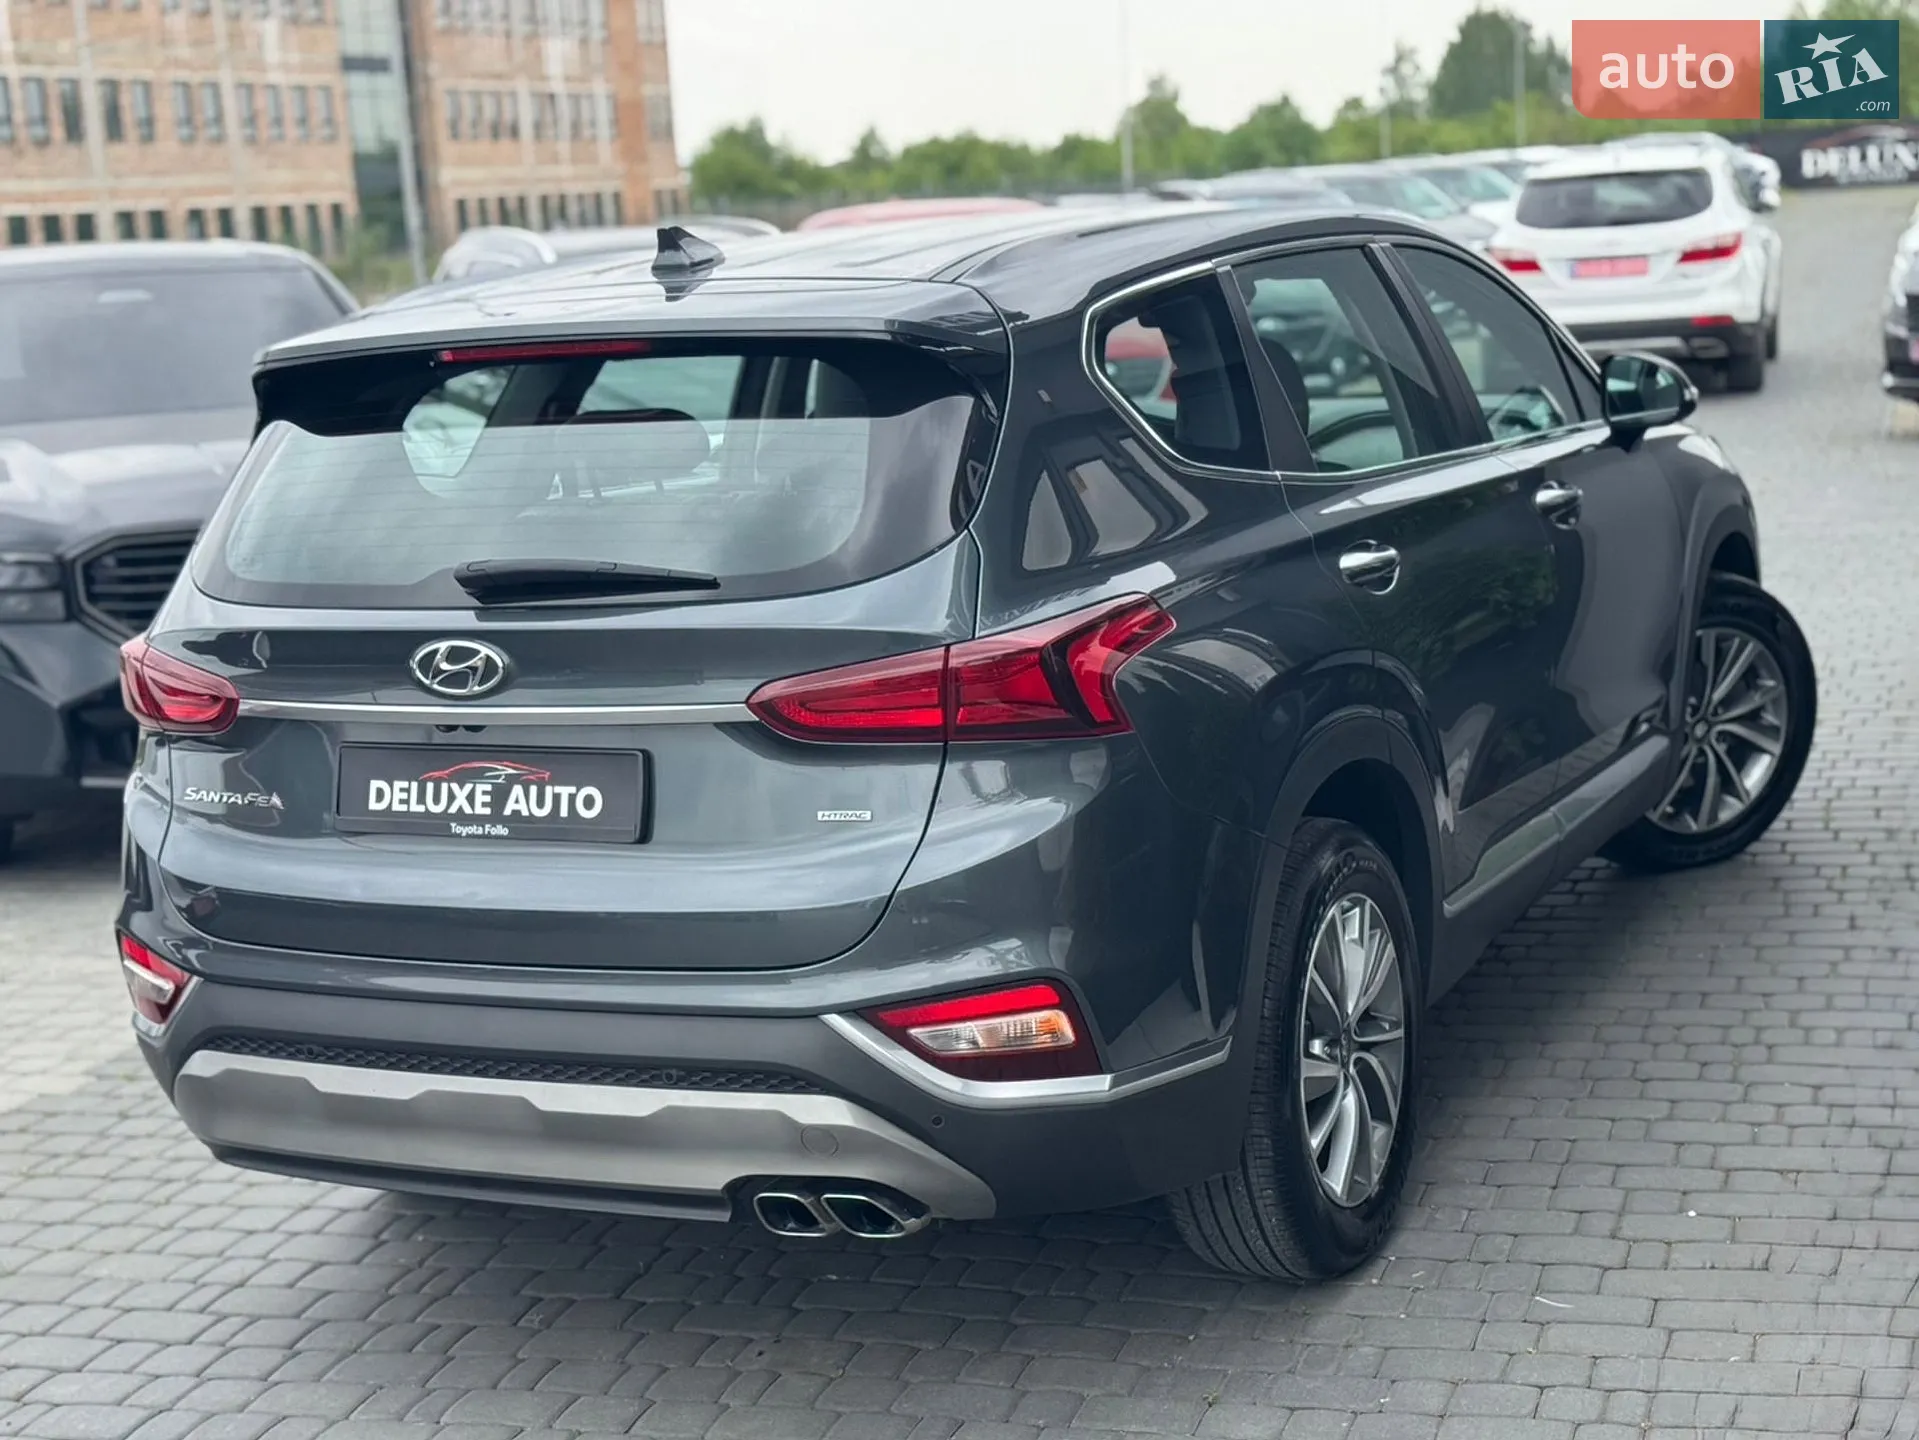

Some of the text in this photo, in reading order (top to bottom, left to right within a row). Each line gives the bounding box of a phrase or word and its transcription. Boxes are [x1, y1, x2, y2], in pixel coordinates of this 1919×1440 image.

[368, 780, 604, 819] DELUXE AUTO
[819, 811, 870, 821] HTRAC
[450, 822, 483, 837] Toyota
